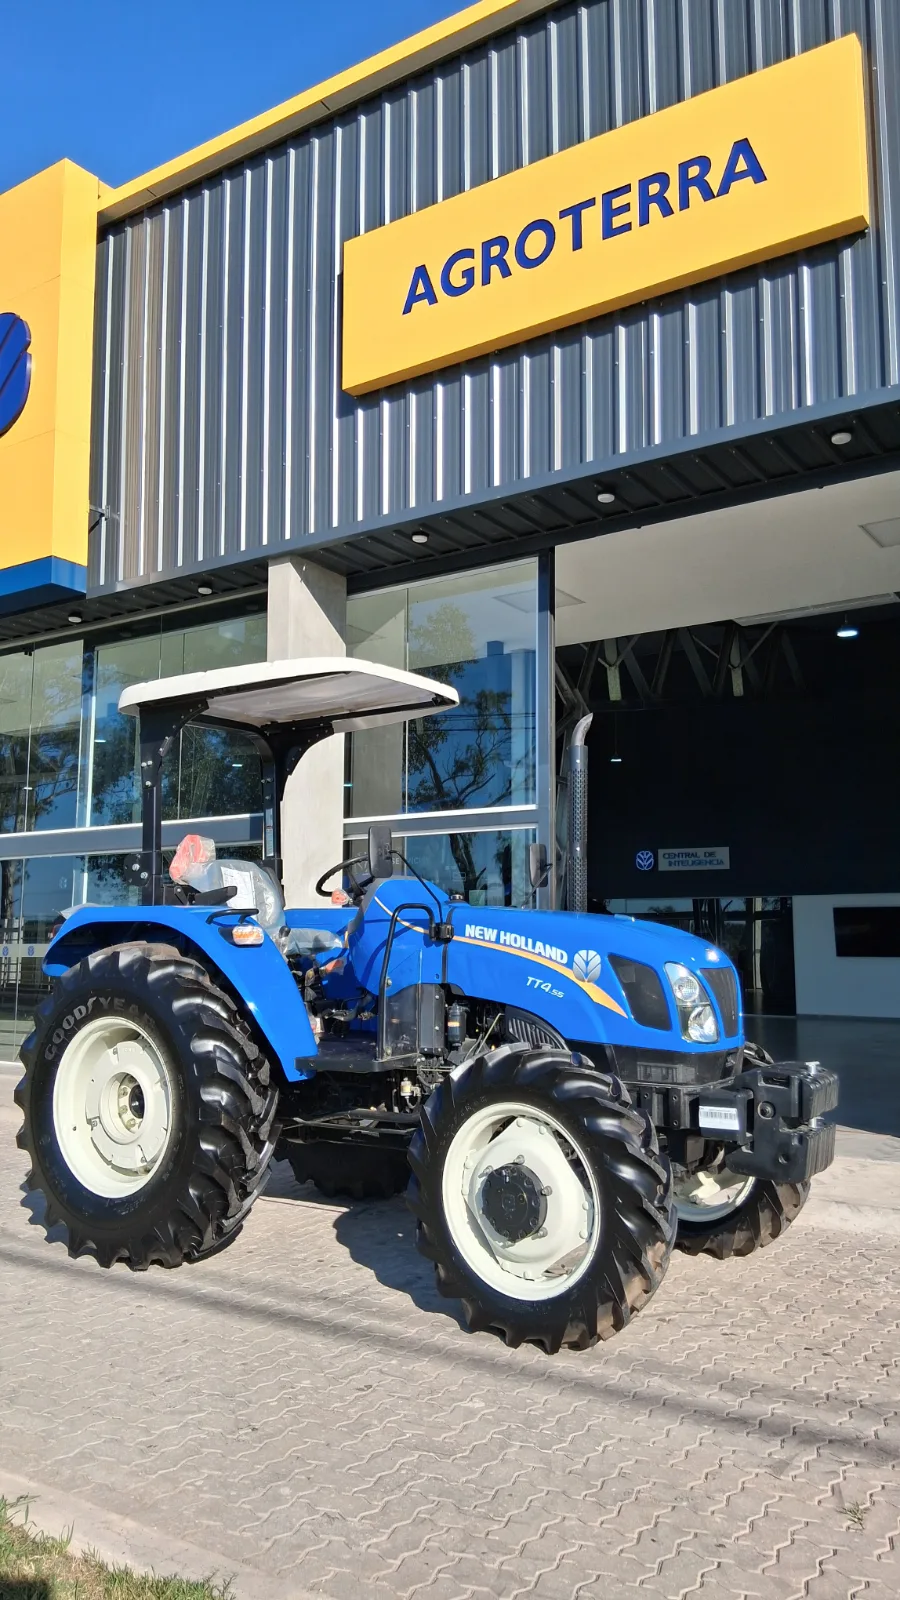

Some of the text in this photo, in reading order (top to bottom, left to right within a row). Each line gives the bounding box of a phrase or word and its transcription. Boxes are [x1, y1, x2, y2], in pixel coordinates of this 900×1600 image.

[402, 137, 767, 315] AGROTERRA
[668, 859, 725, 867] INTELIGENCIA
[465, 924, 568, 965] NEW HOLLAND
[526, 976, 565, 998] TT4.55
[44, 996, 156, 1061] GOODYEAR
